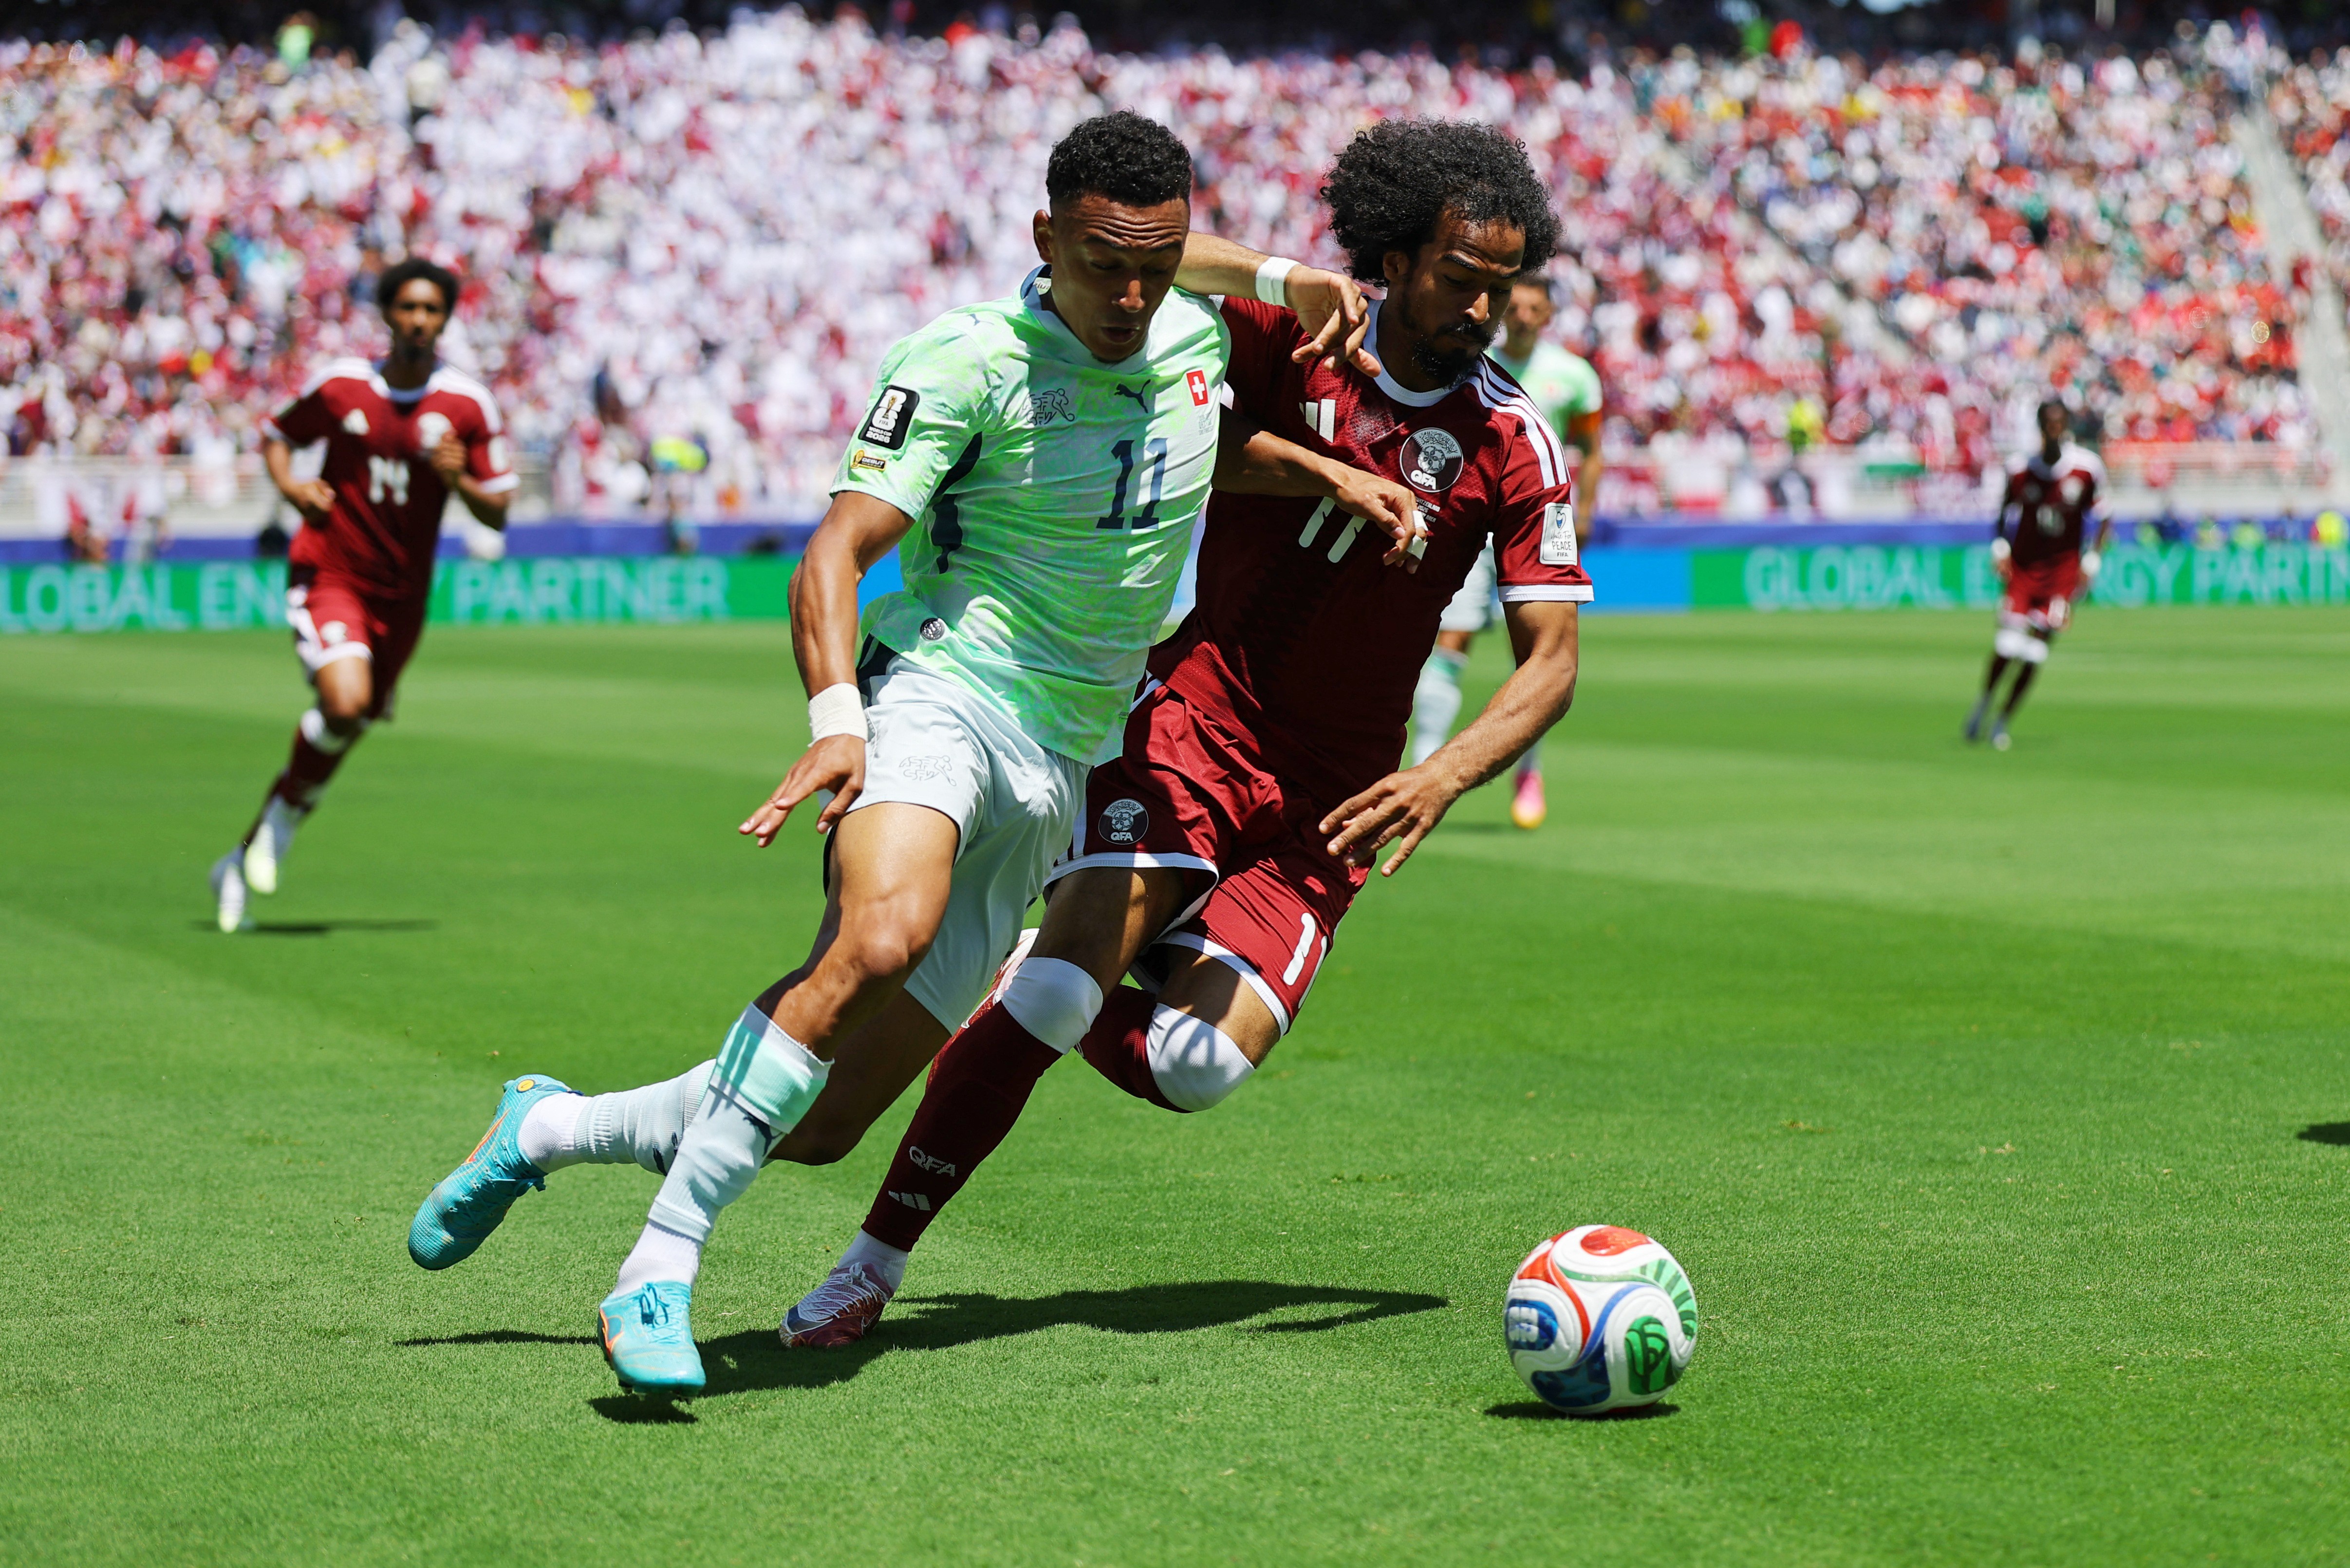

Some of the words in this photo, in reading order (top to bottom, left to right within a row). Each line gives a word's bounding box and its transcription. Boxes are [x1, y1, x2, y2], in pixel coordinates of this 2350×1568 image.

[865, 430, 891, 444] 2026
[869, 426, 884, 434] WORLD
[861, 457, 885, 466] DEBUT
[1096, 438, 1169, 529] 11
[1410, 469, 1436, 490] QFA
[1415, 496, 1440, 512] WITZERLAND
[1551, 541, 1572, 551] PEACE
[1744, 543, 1956, 611] GLOBAL
[453, 558, 729, 623] PARTNER
[1110, 832, 1134, 841] QFA
[909, 1146, 956, 1177] QFA
